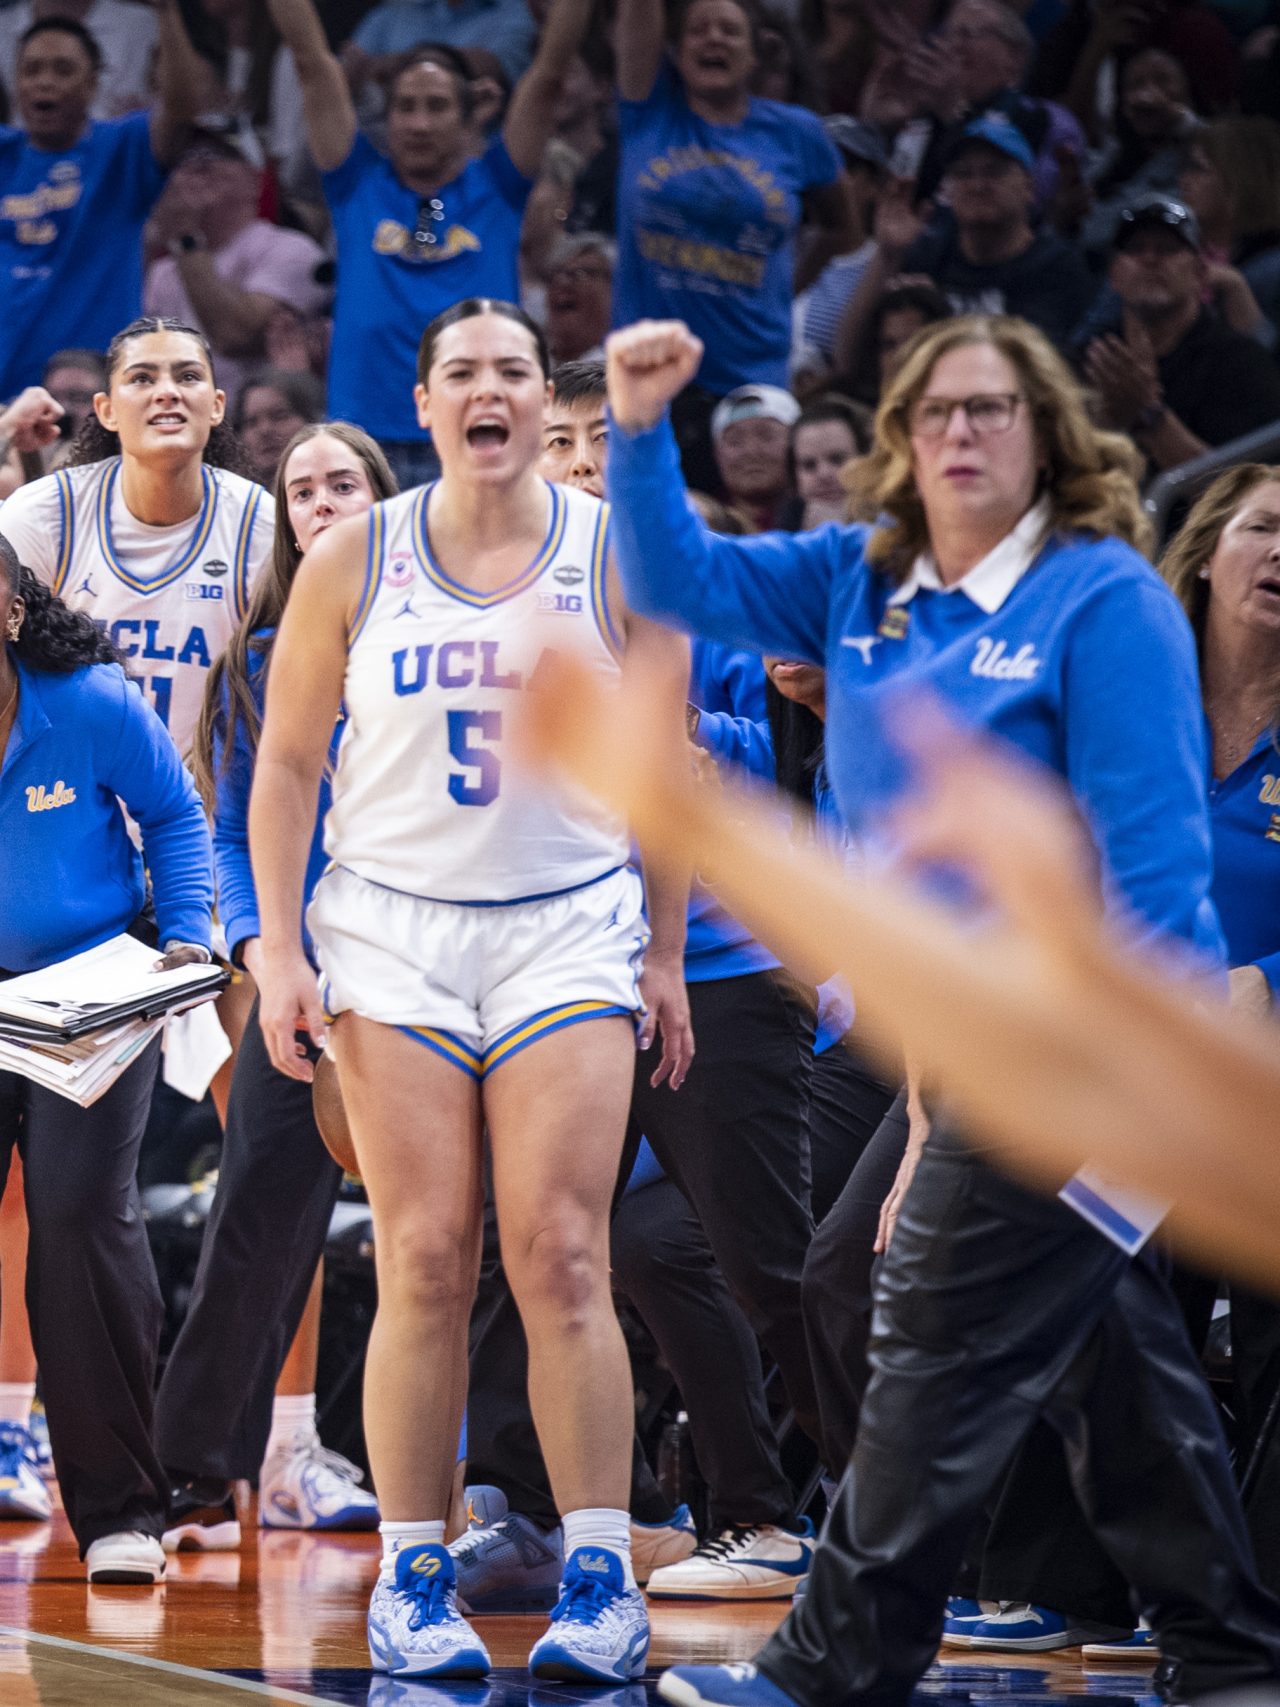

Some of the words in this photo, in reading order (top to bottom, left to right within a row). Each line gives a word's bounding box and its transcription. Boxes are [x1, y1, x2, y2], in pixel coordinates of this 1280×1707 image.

[93, 619, 212, 669] CLA
[447, 709, 502, 808] 5
[25, 780, 77, 813] Ucla
